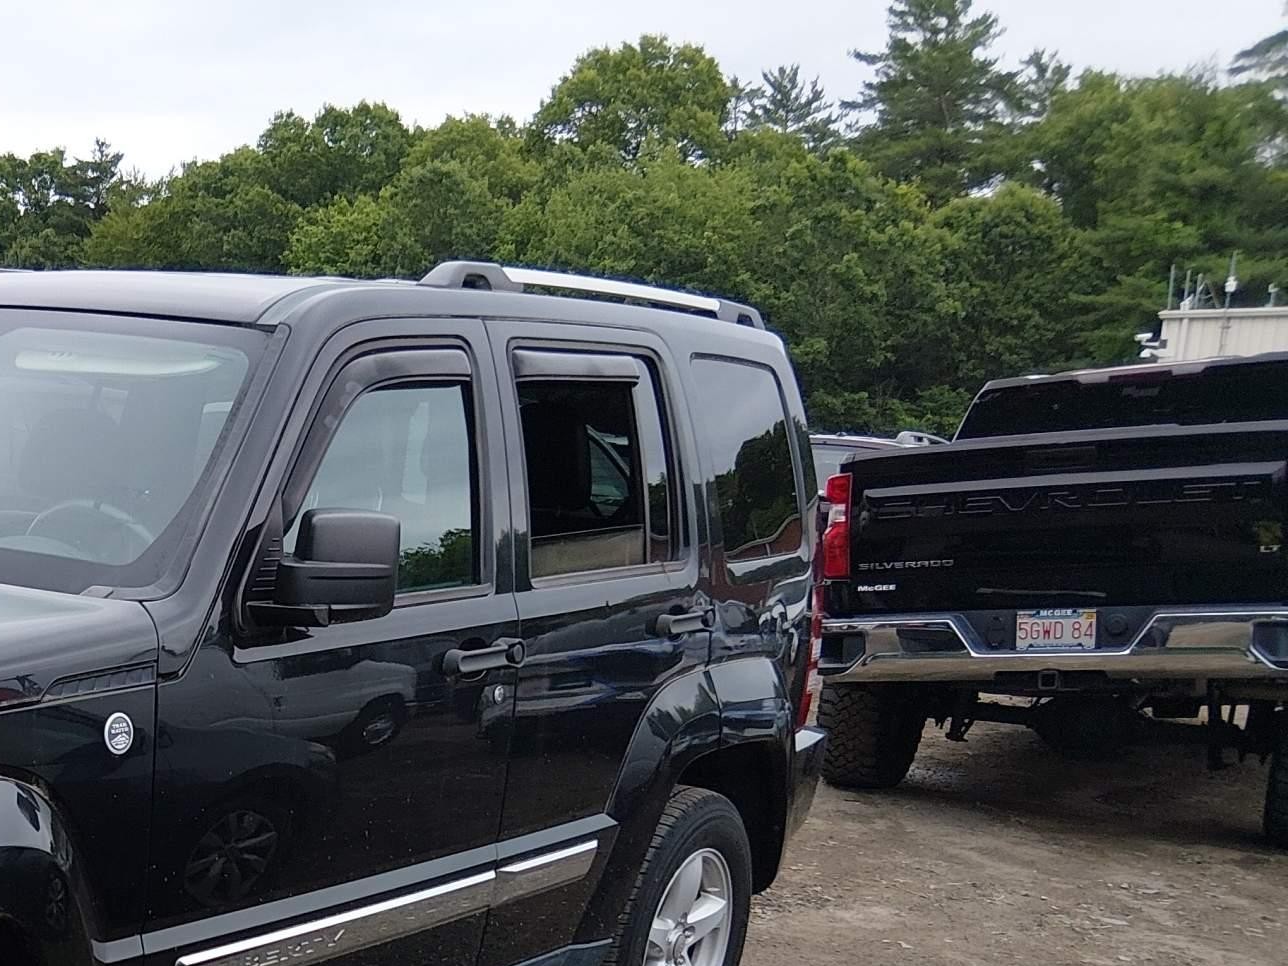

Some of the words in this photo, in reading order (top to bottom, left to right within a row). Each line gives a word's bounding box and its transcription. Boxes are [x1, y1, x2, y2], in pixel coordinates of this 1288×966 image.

[858, 559, 954, 570] SILVERADO
[857, 584, 896, 592] McGEE
[1018, 621, 1064, 640] 5GWD
[1071, 620, 1094, 640] 84
